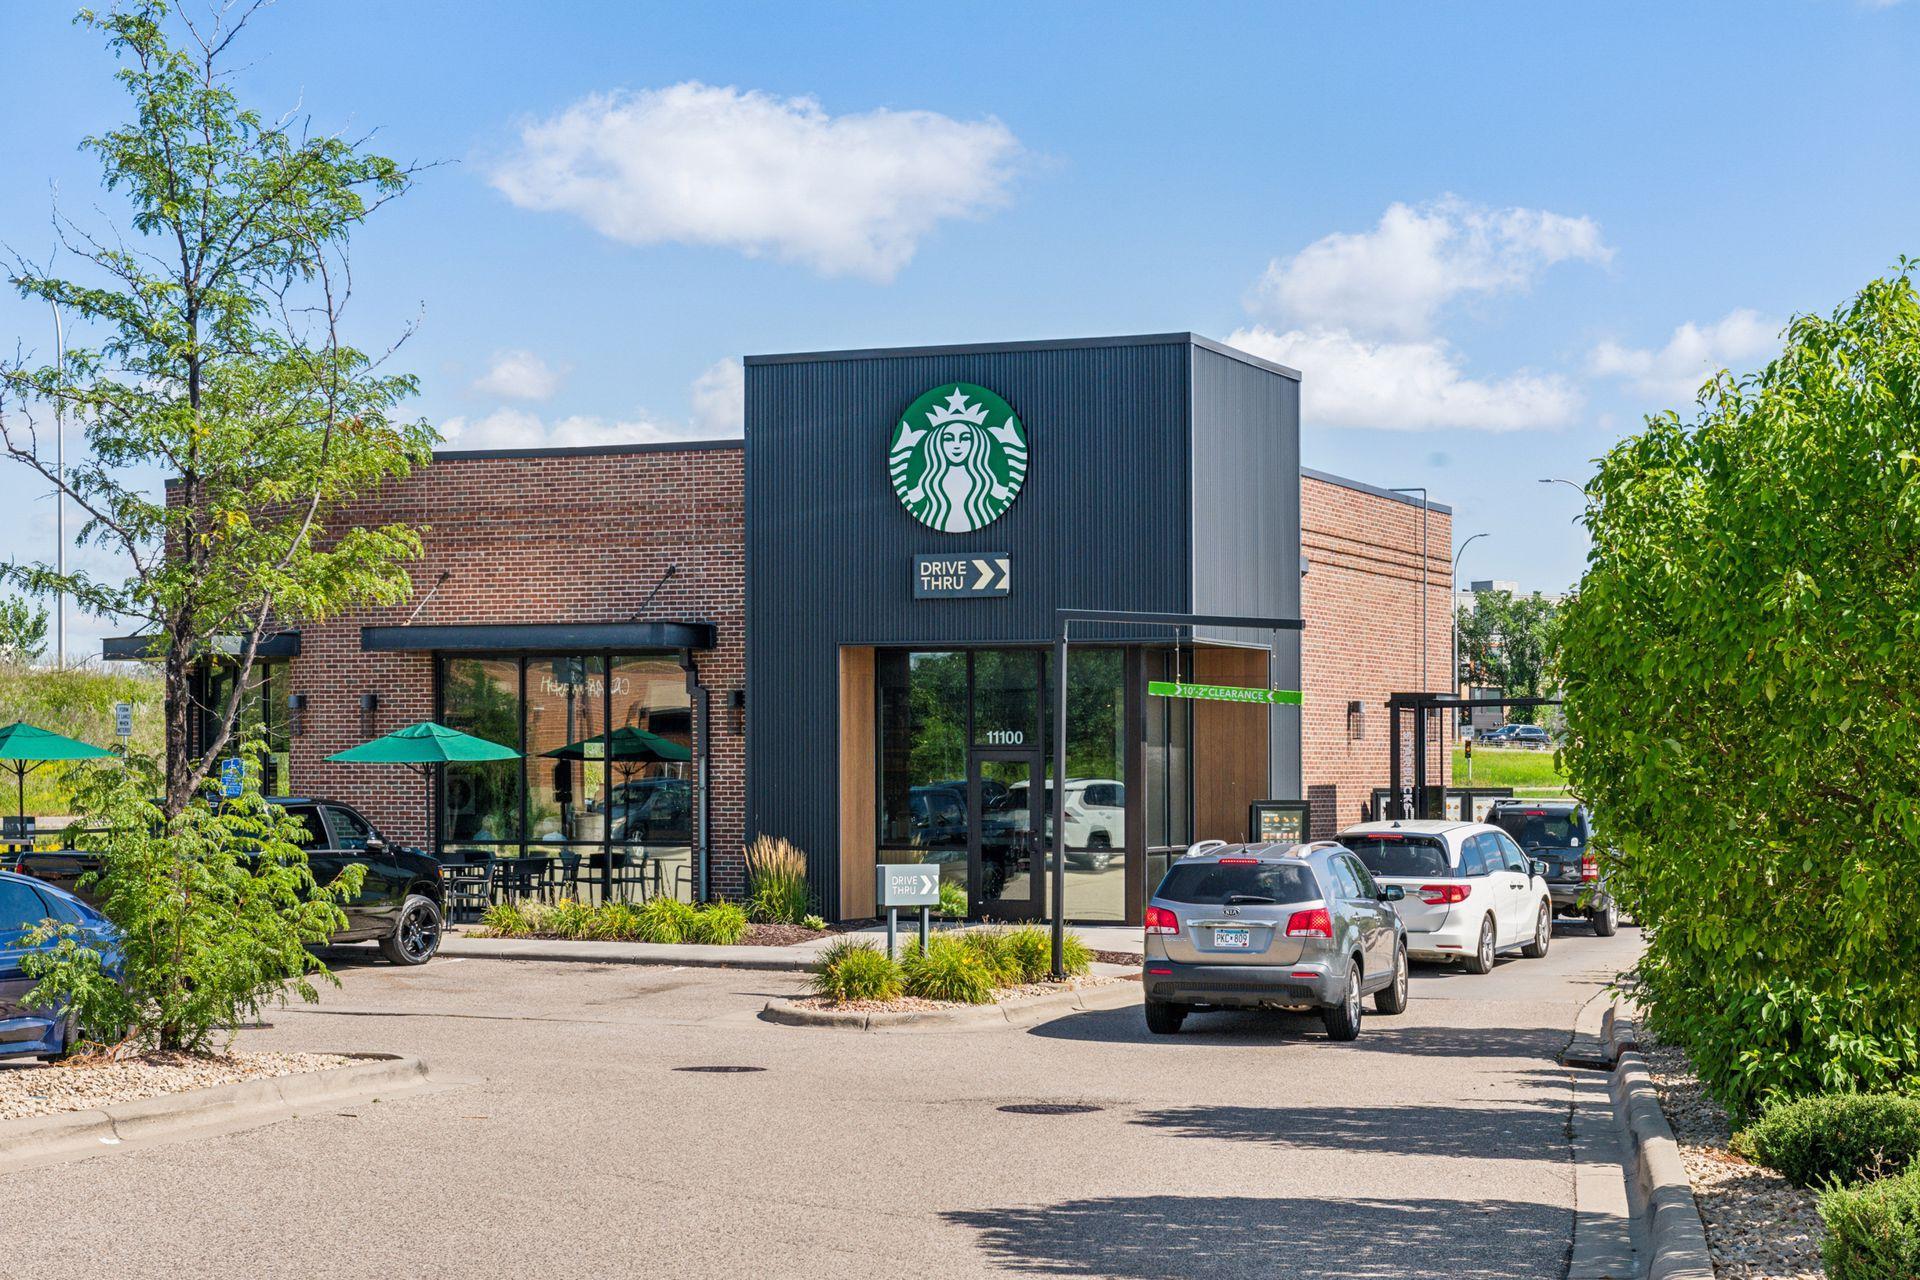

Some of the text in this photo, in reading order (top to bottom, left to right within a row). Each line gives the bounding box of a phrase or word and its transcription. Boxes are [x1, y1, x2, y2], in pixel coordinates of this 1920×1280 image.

[920, 561, 967, 575] DRIVE
[920, 576, 964, 591] THRU
[1209, 689, 1263, 700] CLEARANCE
[986, 730, 1024, 745] 11100
[891, 875, 918, 886] DRIVE
[892, 886, 917, 896] THRU
